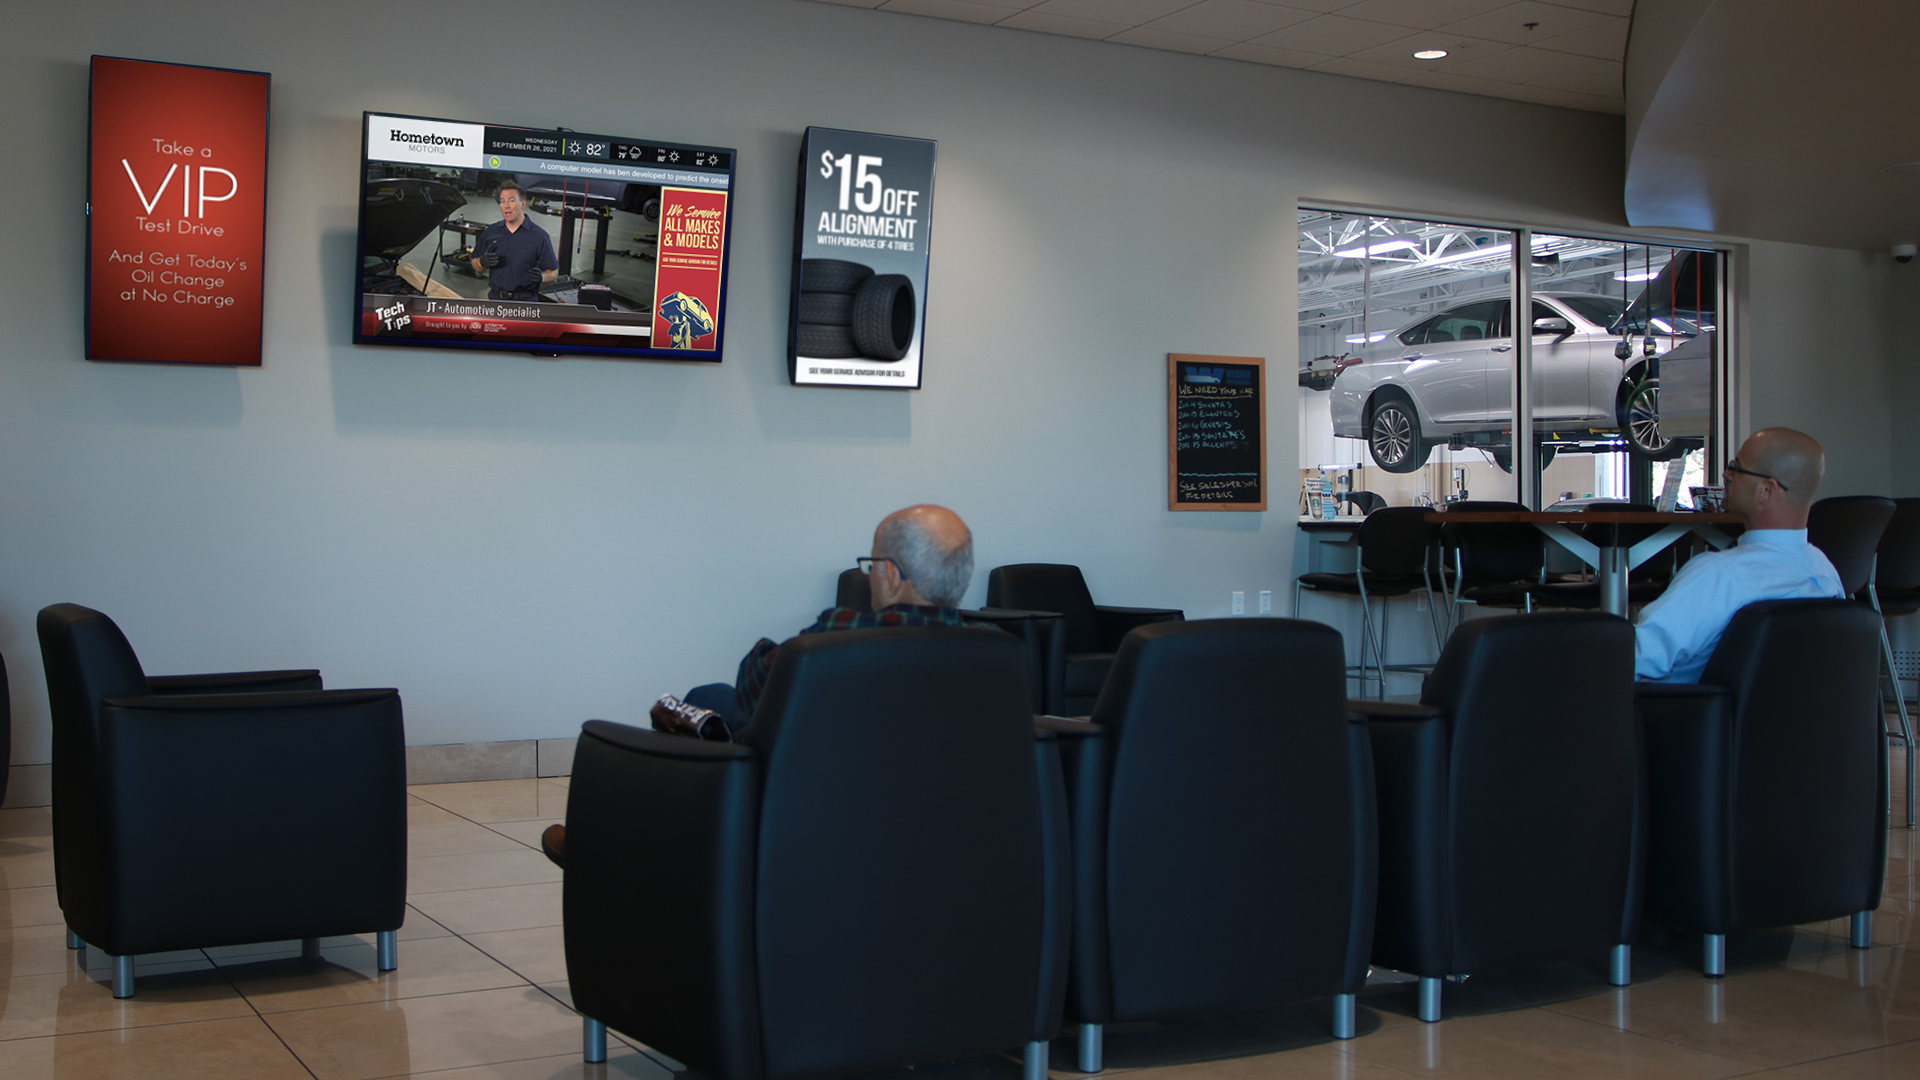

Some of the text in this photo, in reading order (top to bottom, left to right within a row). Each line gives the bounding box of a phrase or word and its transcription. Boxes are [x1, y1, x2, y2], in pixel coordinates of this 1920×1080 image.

[390, 130, 464, 147] Hometown
[492, 141, 531, 151] SEPTEMBER
[152, 138, 212, 158] Take a
[408, 144, 446, 154] MOTORS
[586, 143, 605, 155] 82°
[547, 163, 580, 172] computer
[580, 165, 602, 173] model
[632, 170, 666, 180] developed
[676, 173, 697, 182] predict
[699, 175, 709, 183] the
[711, 177, 728, 185] onset
[122, 159, 238, 218] VIP
[820, 150, 919, 216] $15 OFF
[666, 204, 721, 219] We Service
[135, 216, 224, 237] Test Drive
[665, 217, 720, 235] ALL MAKES
[818, 211, 917, 239] ALIGNMENT
[664, 233, 719, 249] & MODELS
[817, 235, 914, 252] WITH PURCHASE OF 4 TIRES
[108, 250, 247, 272] And Get Today's
[131, 269, 224, 289] Oil Change
[120, 289, 234, 308] at No Charge
[376, 302, 405, 321] Tech
[426, 302, 437, 313] JT
[444, 303, 495, 316] Automotive
[497, 305, 541, 318] Specialist
[384, 313, 411, 331] Tips
[425, 321, 445, 330] Brought
[462, 322, 467, 330] by
[1226, 369, 1251, 379] WERNER
[1179, 384, 1193, 394] WE
[1195, 386, 1217, 394] NEED
[1180, 481, 1196, 492] SEE
